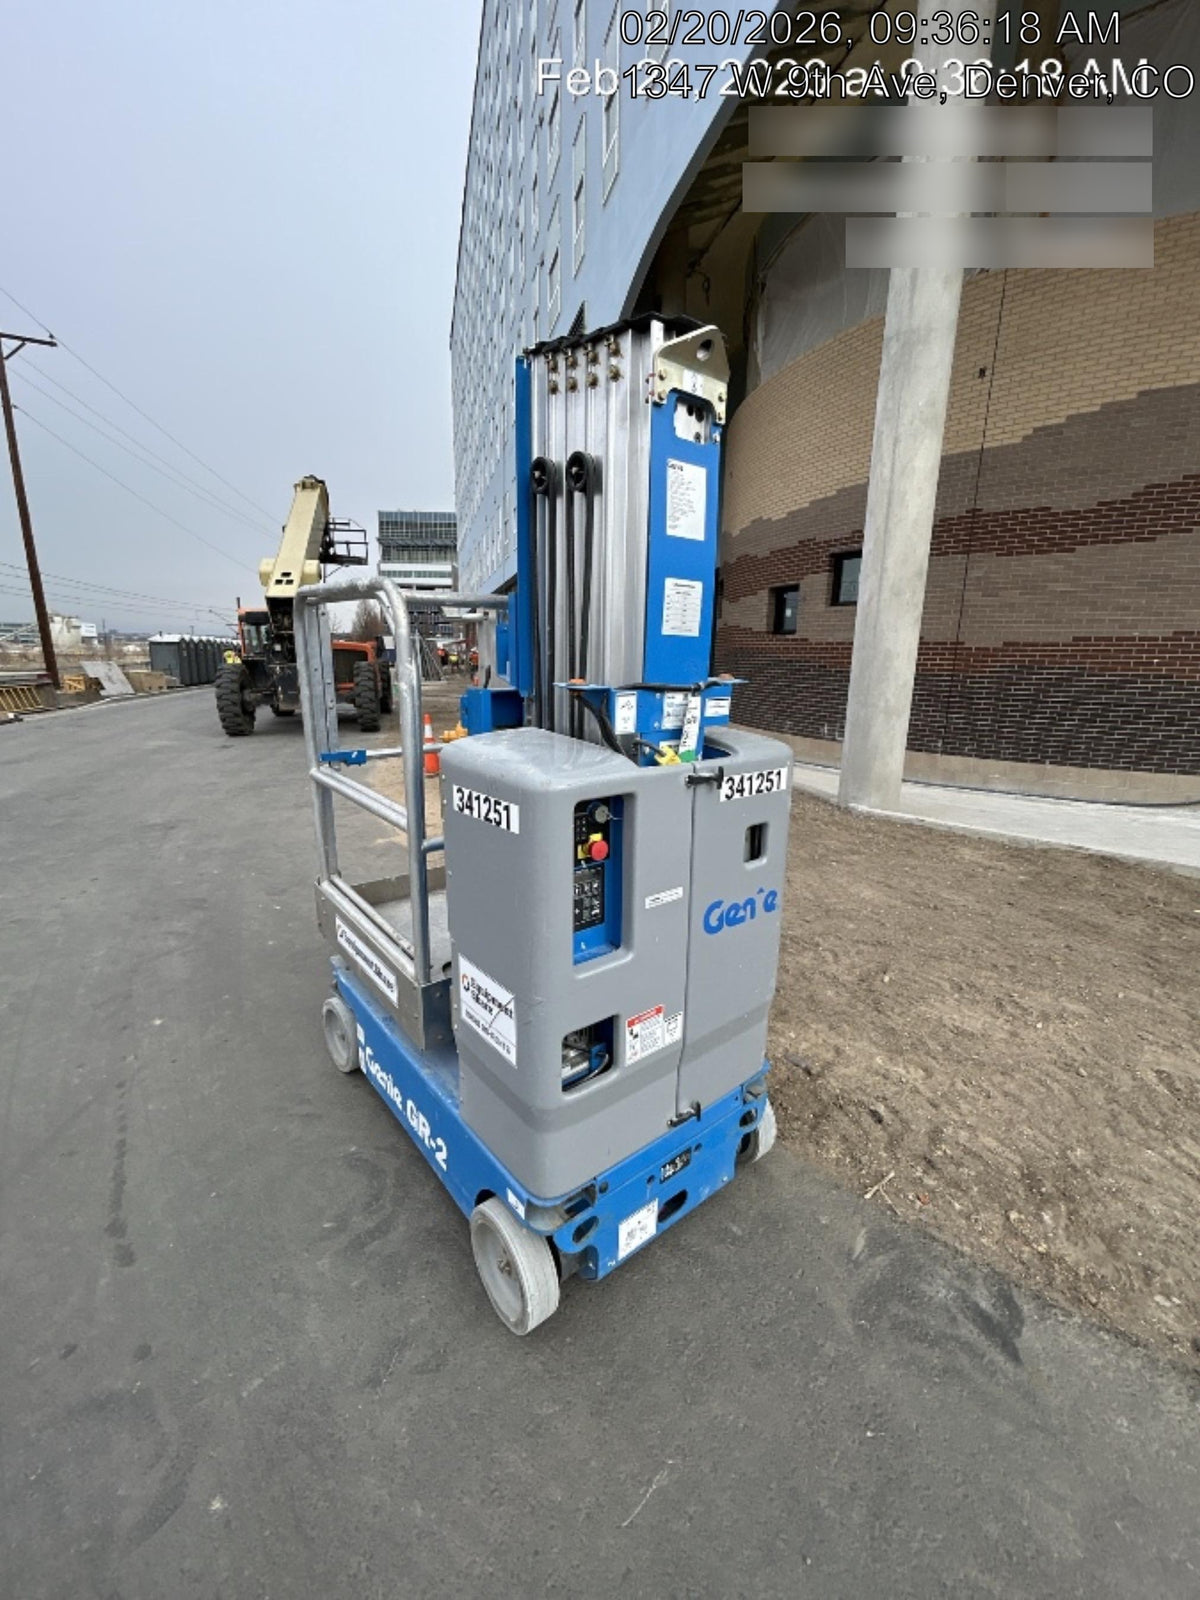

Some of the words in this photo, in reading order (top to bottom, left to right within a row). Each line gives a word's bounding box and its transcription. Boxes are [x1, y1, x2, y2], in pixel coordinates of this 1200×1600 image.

[724, 769, 782, 801] 341251
[456, 786, 511, 831] 341251
[703, 887, 778, 935] Genie
